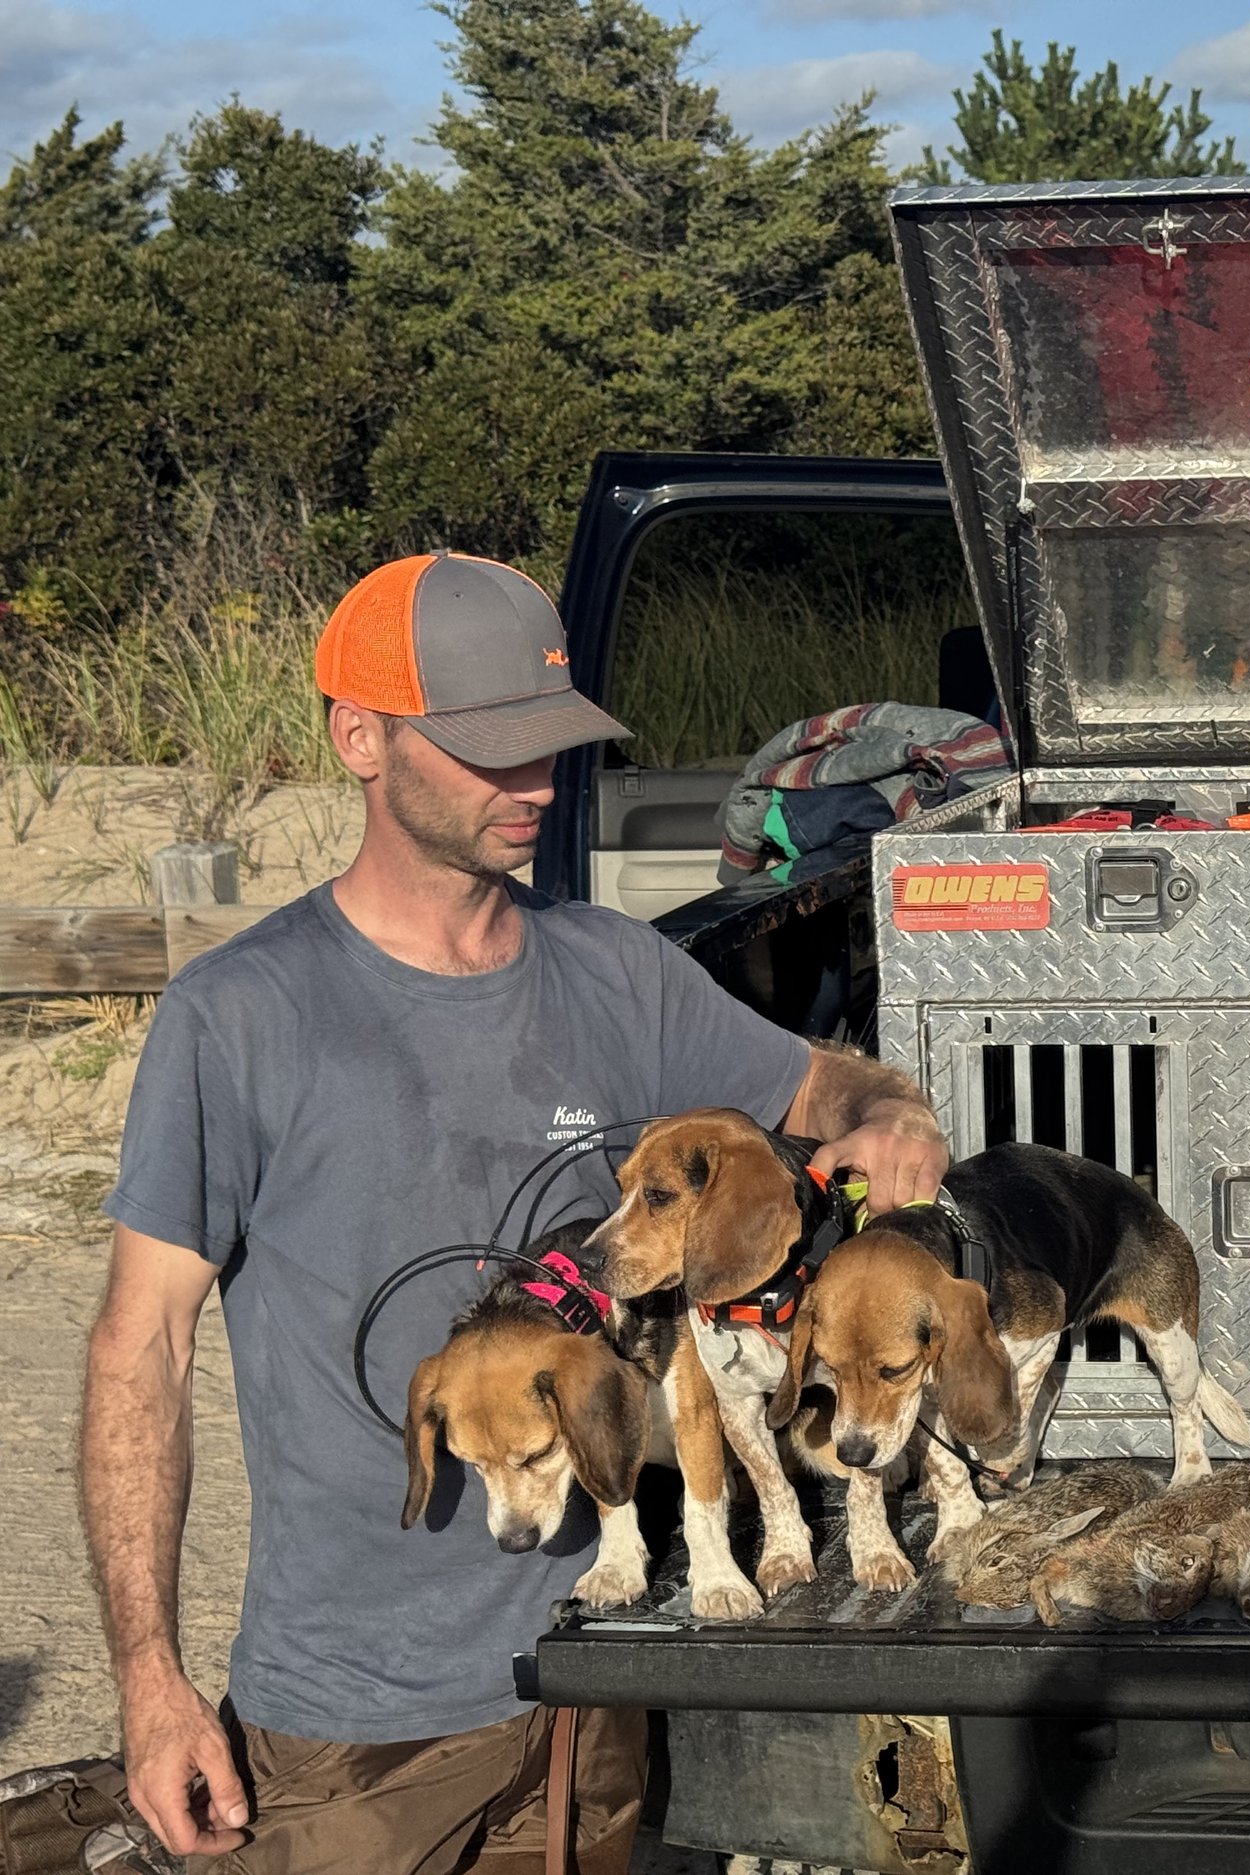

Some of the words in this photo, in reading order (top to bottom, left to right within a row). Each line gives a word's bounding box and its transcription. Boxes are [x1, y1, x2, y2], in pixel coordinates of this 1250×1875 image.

[904, 875, 1046, 904] OWENS
[1018, 903, 1037, 913] Inc.
[553, 1105, 596, 1126] Katin
[546, 1130, 578, 1141] CUSTOM
